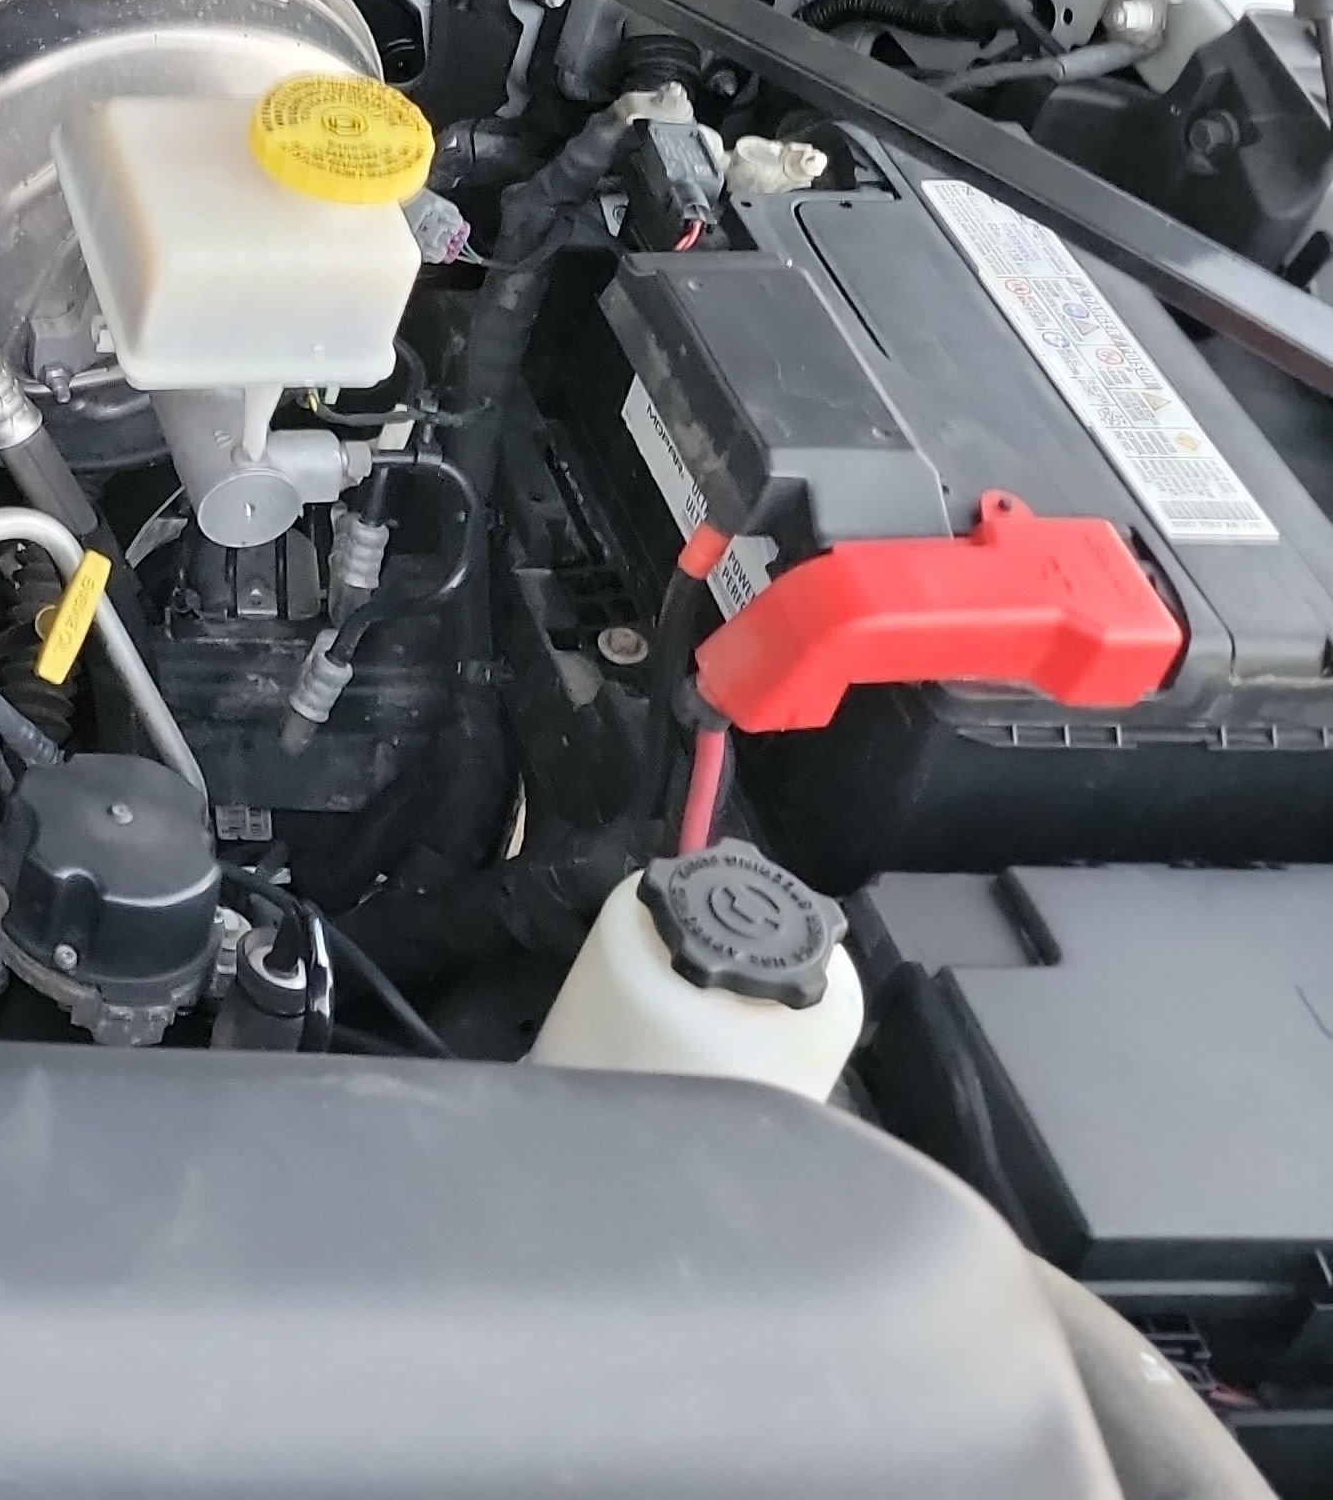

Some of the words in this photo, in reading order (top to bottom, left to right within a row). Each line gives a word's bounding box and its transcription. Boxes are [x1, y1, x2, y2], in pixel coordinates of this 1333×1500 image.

[1082, 296, 1121, 336] DANGER
[1119, 346, 1159, 387] POISON
[646, 403, 684, 476] MOPAR
